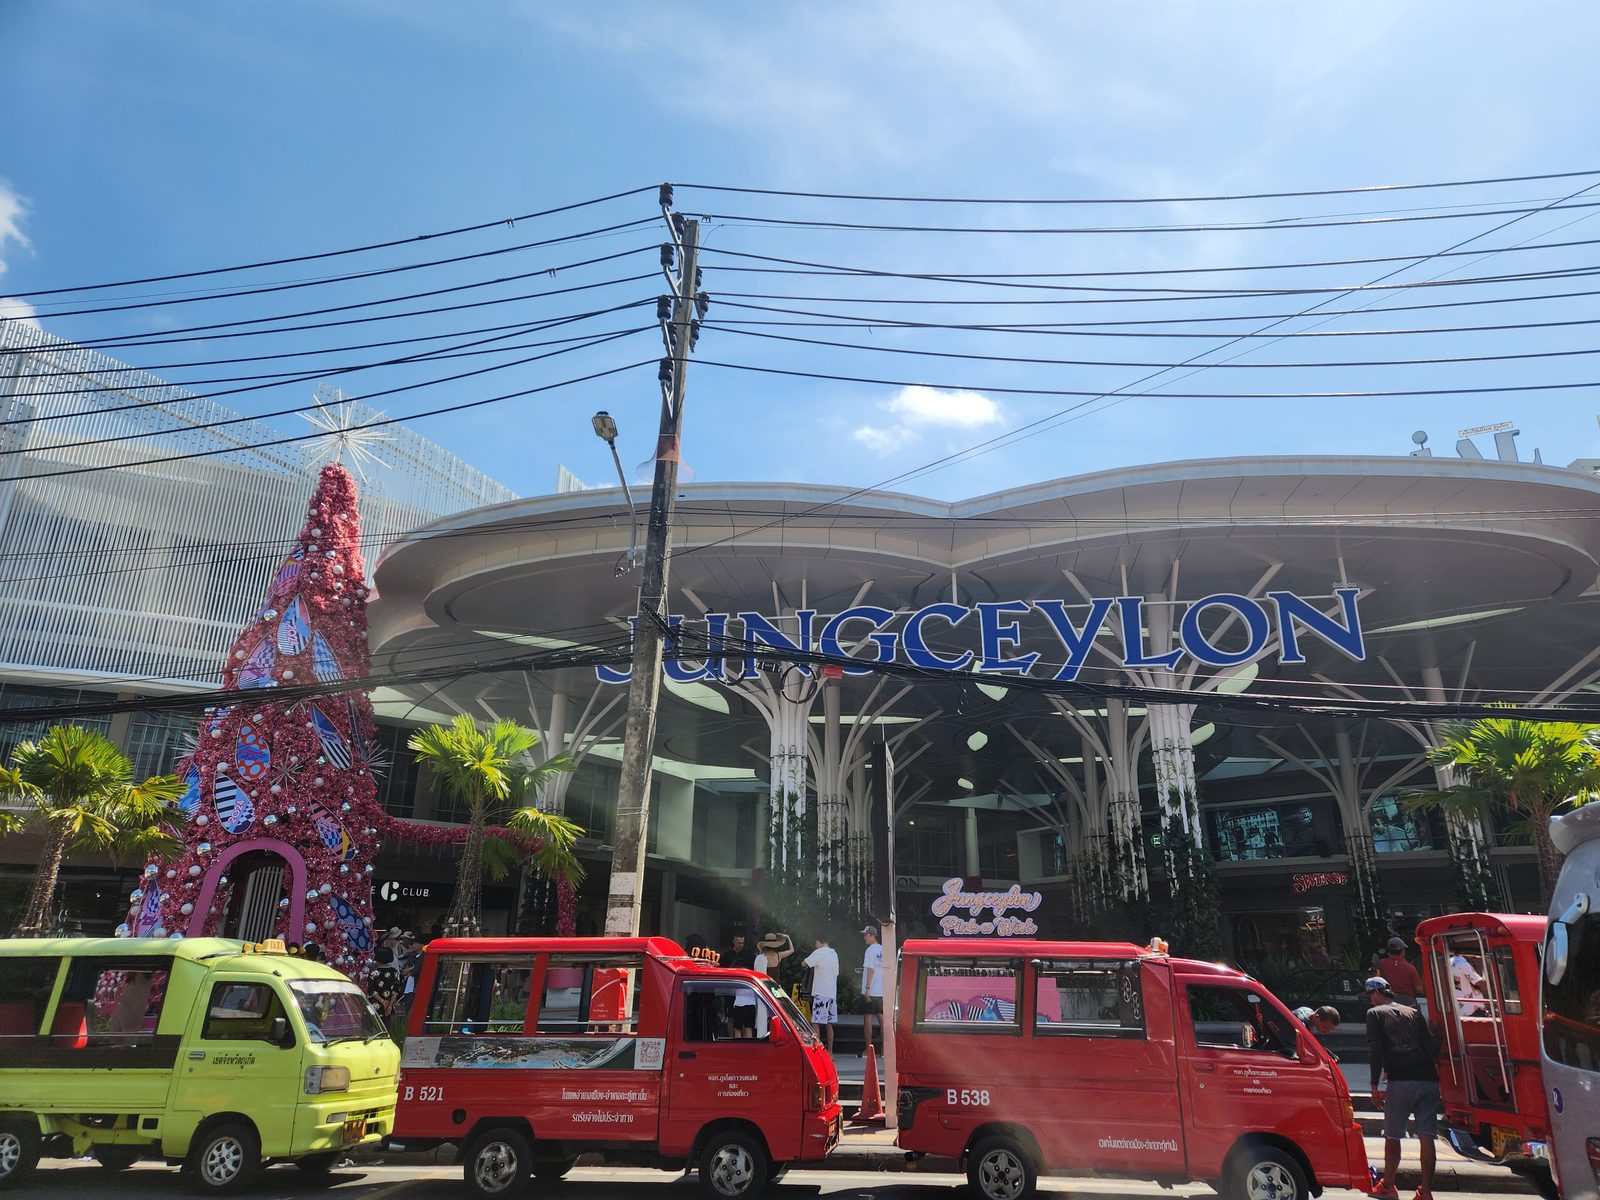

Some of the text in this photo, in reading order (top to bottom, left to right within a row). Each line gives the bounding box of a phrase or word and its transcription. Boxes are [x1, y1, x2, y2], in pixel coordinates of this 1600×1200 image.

[227, 800, 245, 824] 2024
[402, 887, 429, 897] CLUB
[270, 941, 283, 949] TAXI
[403, 1085, 444, 1101] B 521
[947, 1089, 991, 1106] B 538
